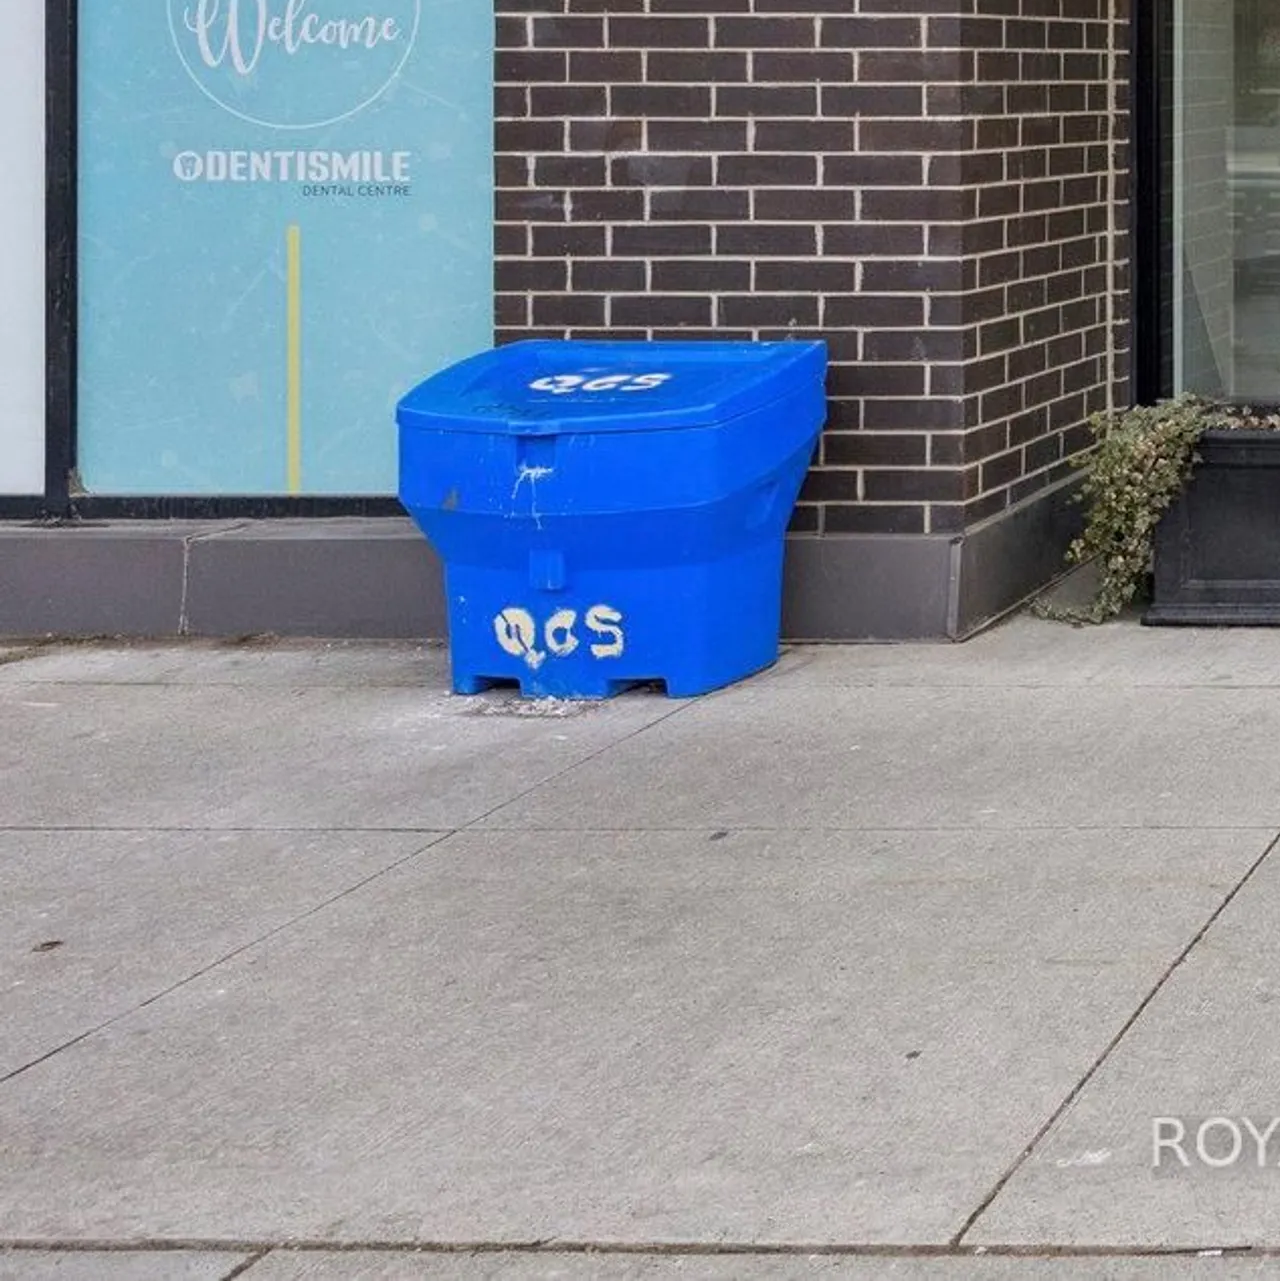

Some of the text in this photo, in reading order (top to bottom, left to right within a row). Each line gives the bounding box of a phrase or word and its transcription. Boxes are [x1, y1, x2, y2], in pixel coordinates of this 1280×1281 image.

[205, 150, 412, 182] DENTISMILE
[302, 185, 412, 197] DENTAL CENTRE
